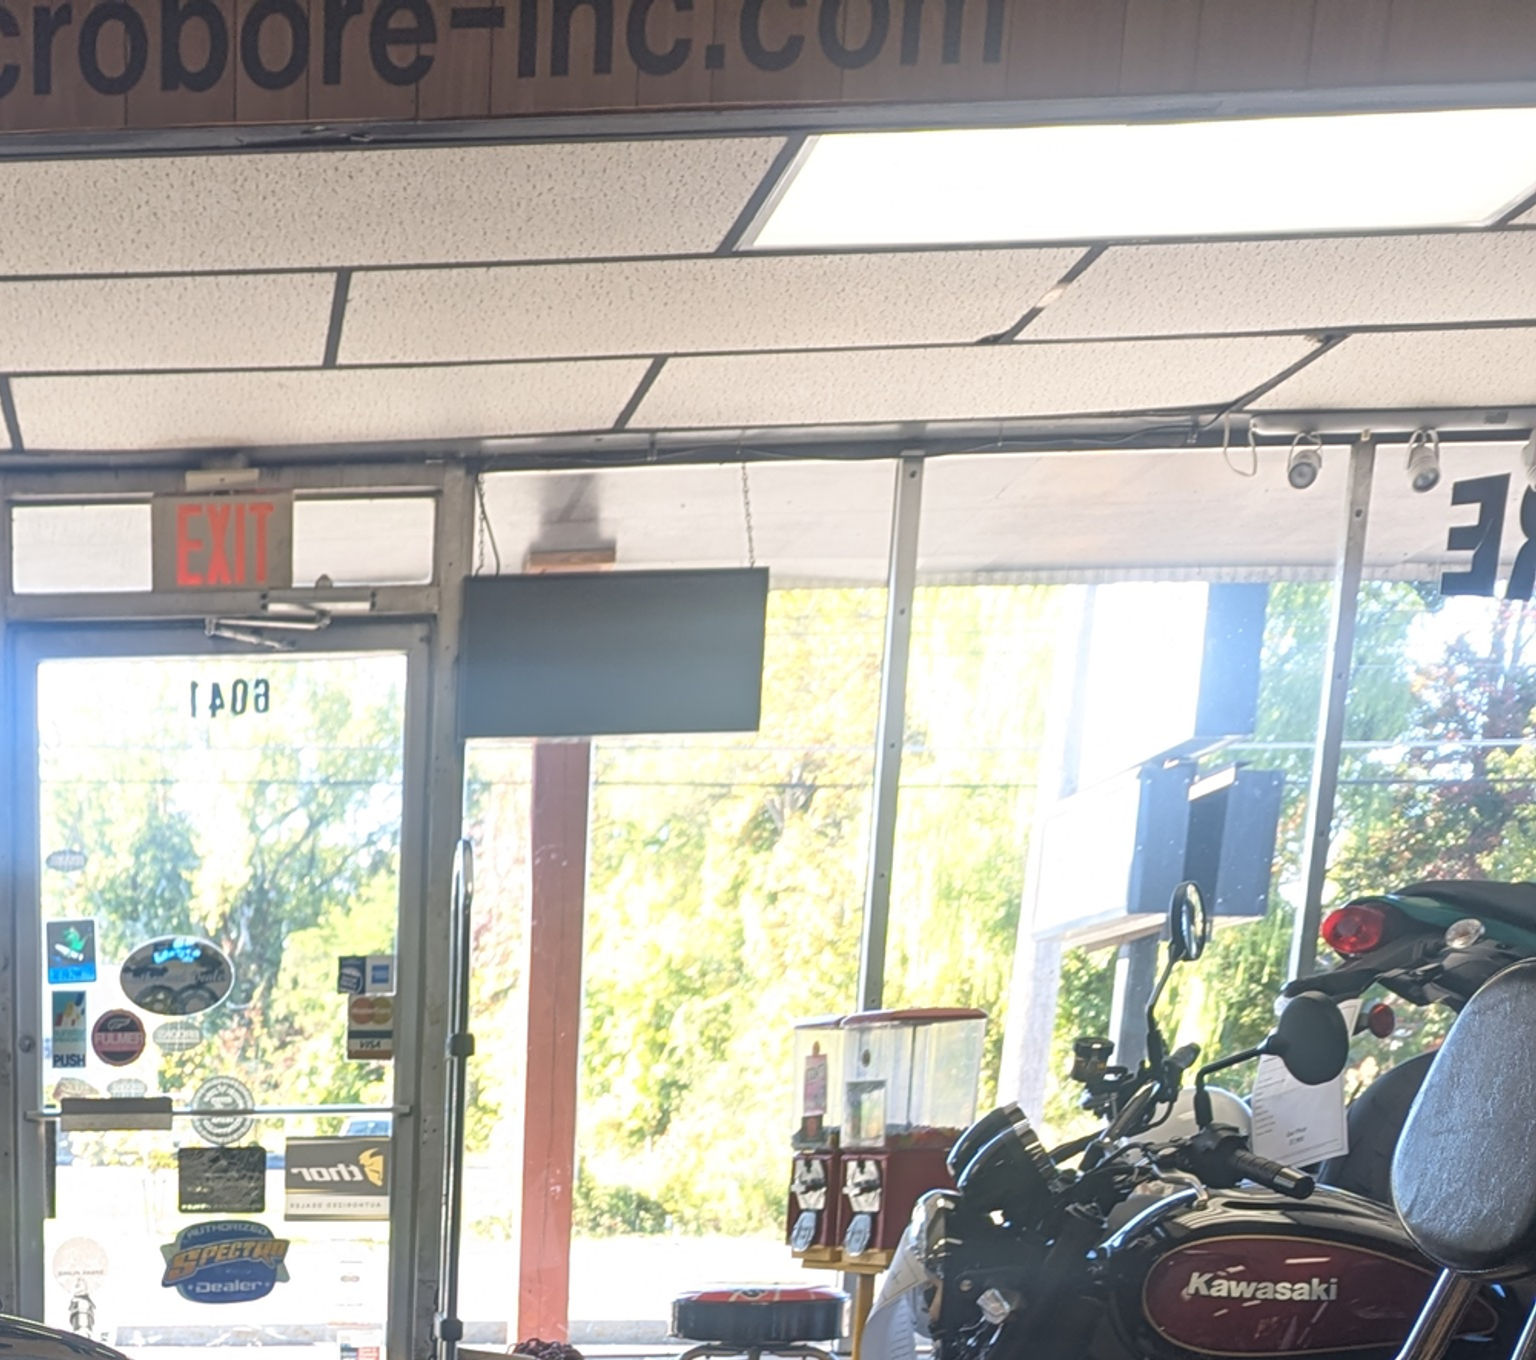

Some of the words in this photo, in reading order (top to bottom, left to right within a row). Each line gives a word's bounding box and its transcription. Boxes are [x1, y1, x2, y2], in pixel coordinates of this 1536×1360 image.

[176, 502, 275, 588] EXIT
[52, 1054, 86, 1068] PUSH
[186, 1224, 269, 1240] AUTHORIZED
[194, 1280, 262, 1294] Dealer
[1187, 1271, 1339, 1302] Kawasaki
